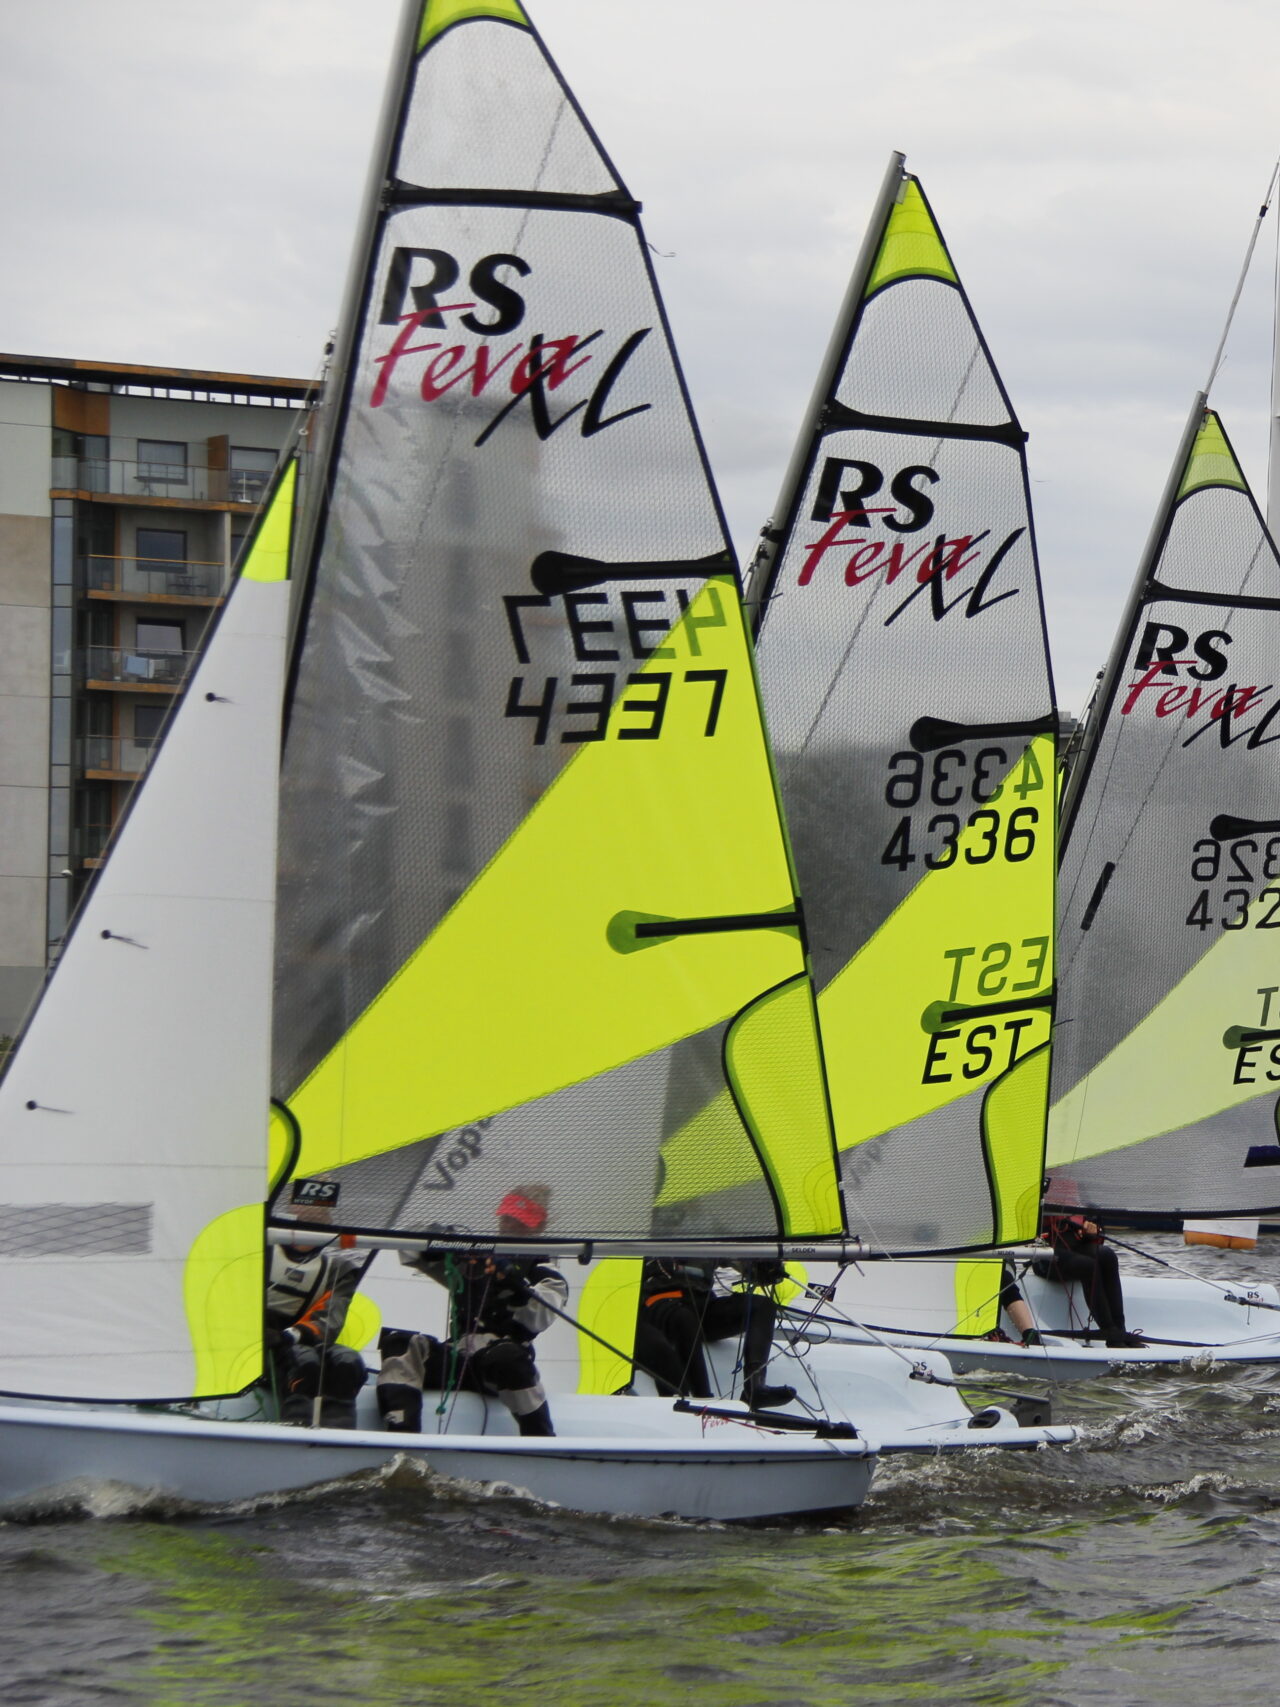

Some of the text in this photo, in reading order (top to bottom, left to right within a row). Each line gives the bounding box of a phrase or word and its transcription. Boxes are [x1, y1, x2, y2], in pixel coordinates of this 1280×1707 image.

[378, 247, 532, 336] RS
[370, 303, 593, 408] Feva
[811, 456, 940, 533] RS
[797, 507, 980, 587] Feva
[1134, 621, 1233, 681] RS
[504, 669, 728, 745] 4337
[1121, 660, 1263, 719] Feva
[881, 806, 1039, 872] 4336
[921, 1017, 1034, 1085] EST
[300, 1182, 336, 1197] RS
